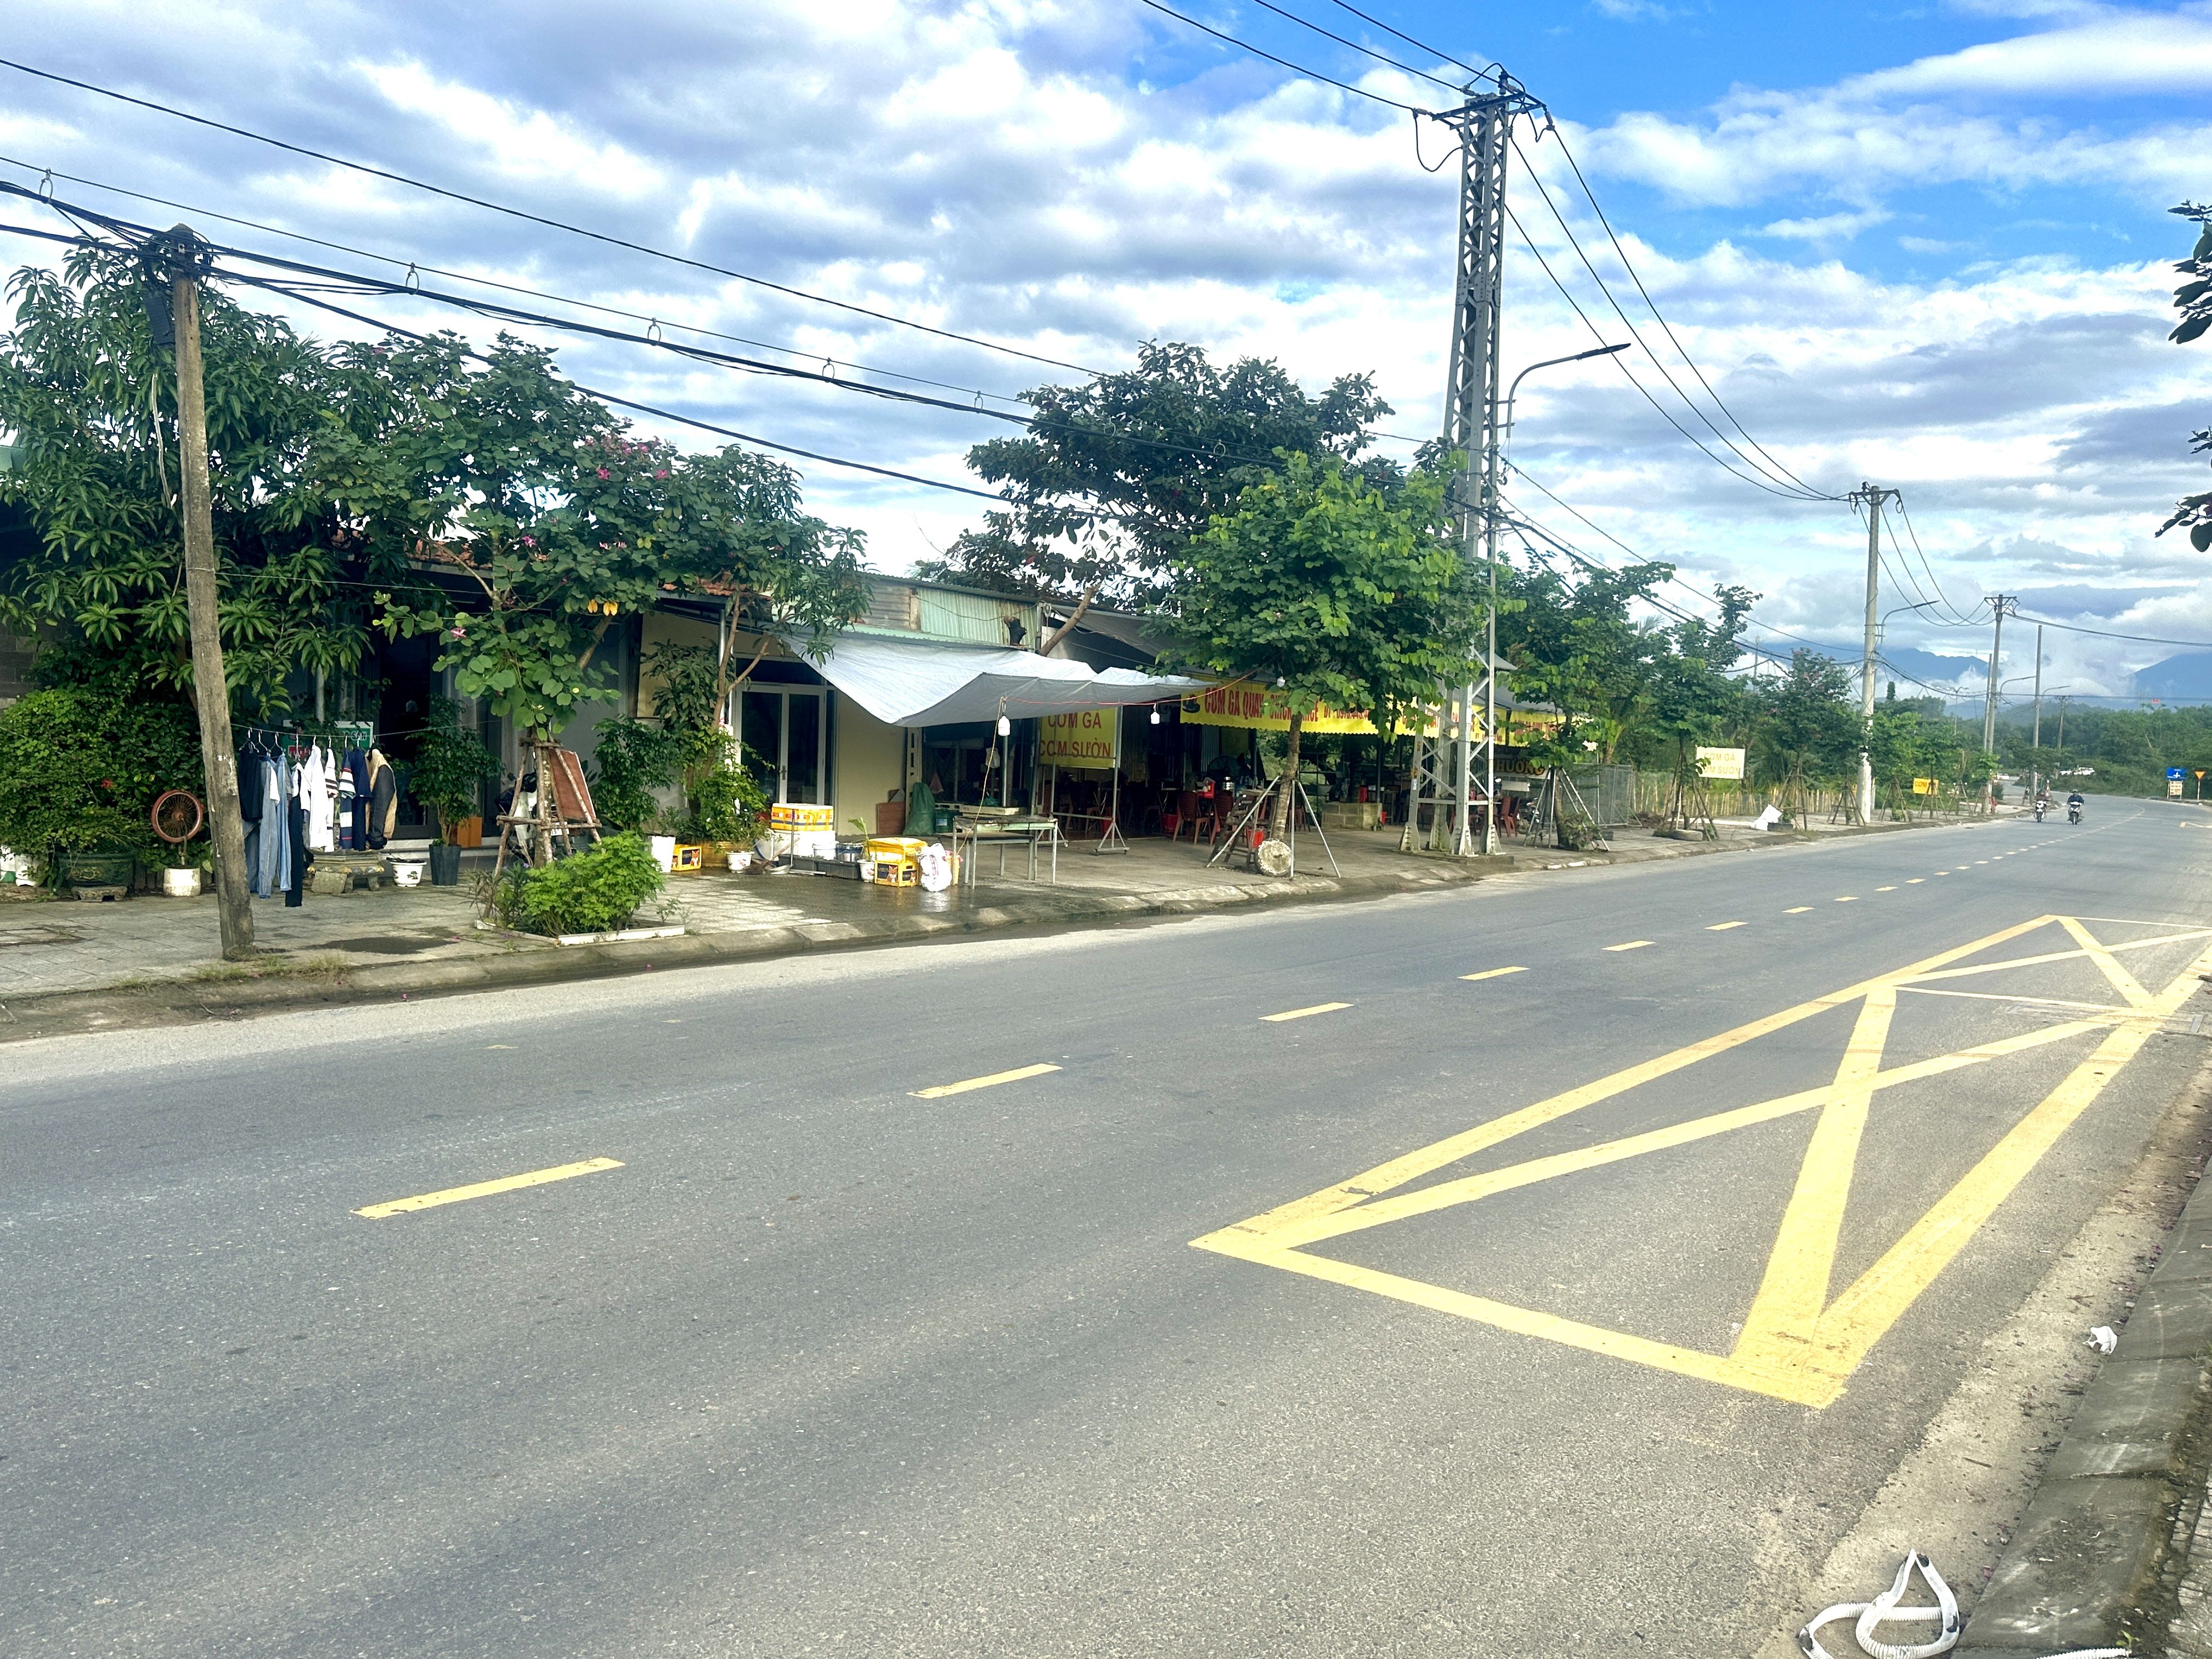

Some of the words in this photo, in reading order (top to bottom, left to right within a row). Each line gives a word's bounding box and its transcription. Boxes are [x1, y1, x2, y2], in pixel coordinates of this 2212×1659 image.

[1205, 685, 1226, 714] CƠM
[1228, 686, 1240, 716] GÀ
[1243, 692, 1264, 720] QUAY
[1072, 737, 1111, 758] SƯỜN
